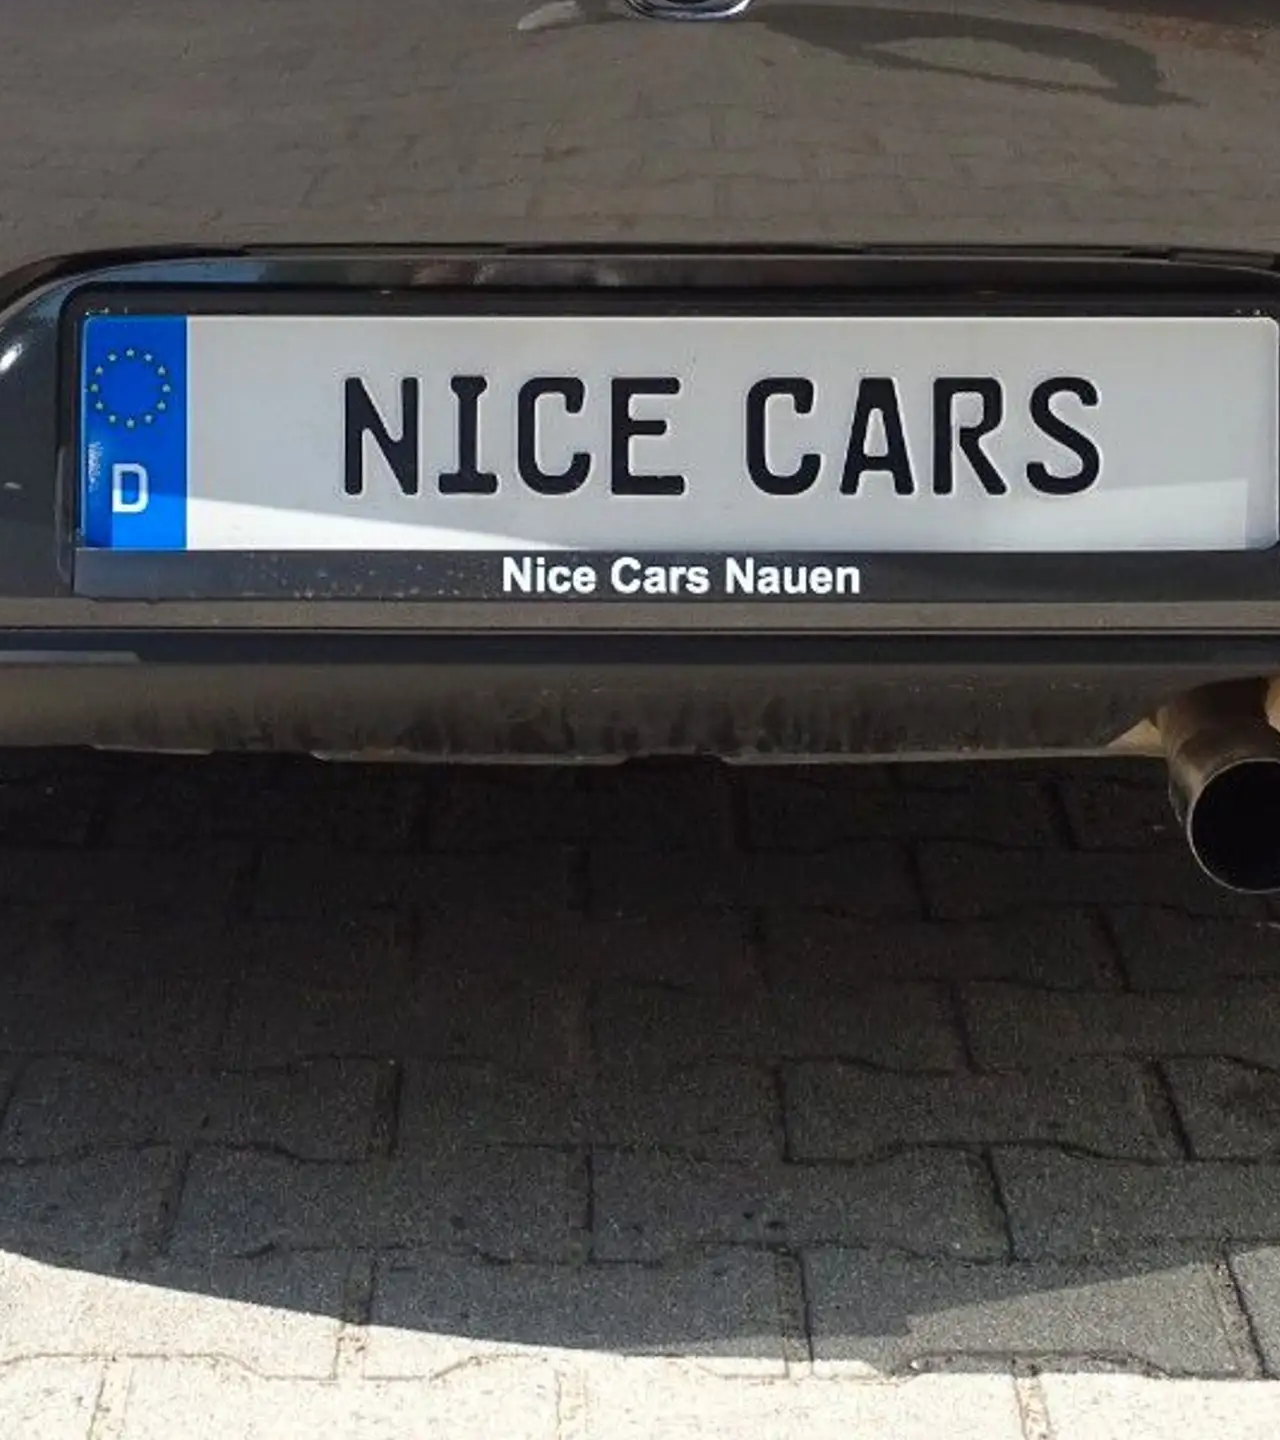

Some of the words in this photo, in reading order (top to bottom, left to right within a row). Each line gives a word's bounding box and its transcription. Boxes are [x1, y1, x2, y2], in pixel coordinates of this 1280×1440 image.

[343, 376, 686, 497] NICE
[745, 376, 1101, 497] CARS
[112, 463, 149, 512] D
[502, 556, 597, 595] Nice
[610, 556, 710, 595] Cars
[724, 556, 861, 595] Nauen
